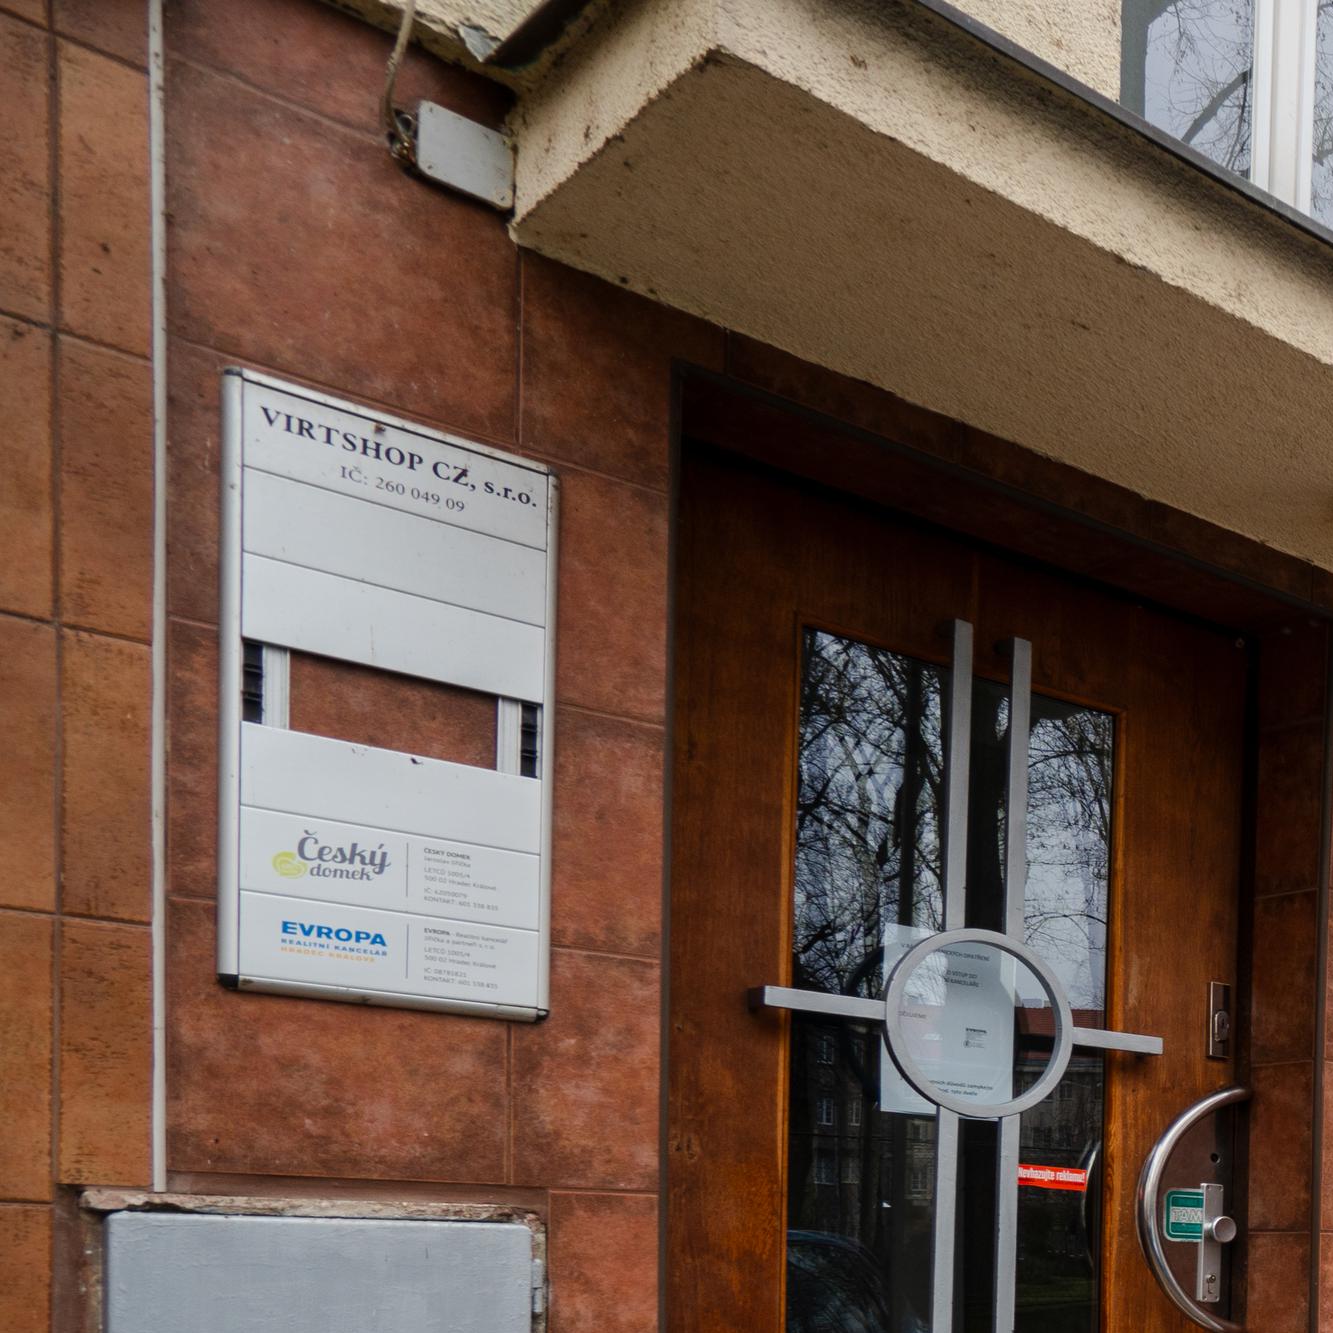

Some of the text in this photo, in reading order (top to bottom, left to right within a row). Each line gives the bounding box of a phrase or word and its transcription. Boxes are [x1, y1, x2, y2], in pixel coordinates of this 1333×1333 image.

[260, 406, 424, 471] VIRTSHOP
[484, 479, 538, 508] s.r.o.
[376, 477, 406, 497] 260
[411, 488, 440, 505] 049
[446, 498, 465, 513] 09
[298, 830, 391, 875] Český
[310, 863, 373, 881] domek
[281, 920, 388, 947] EVROPA
